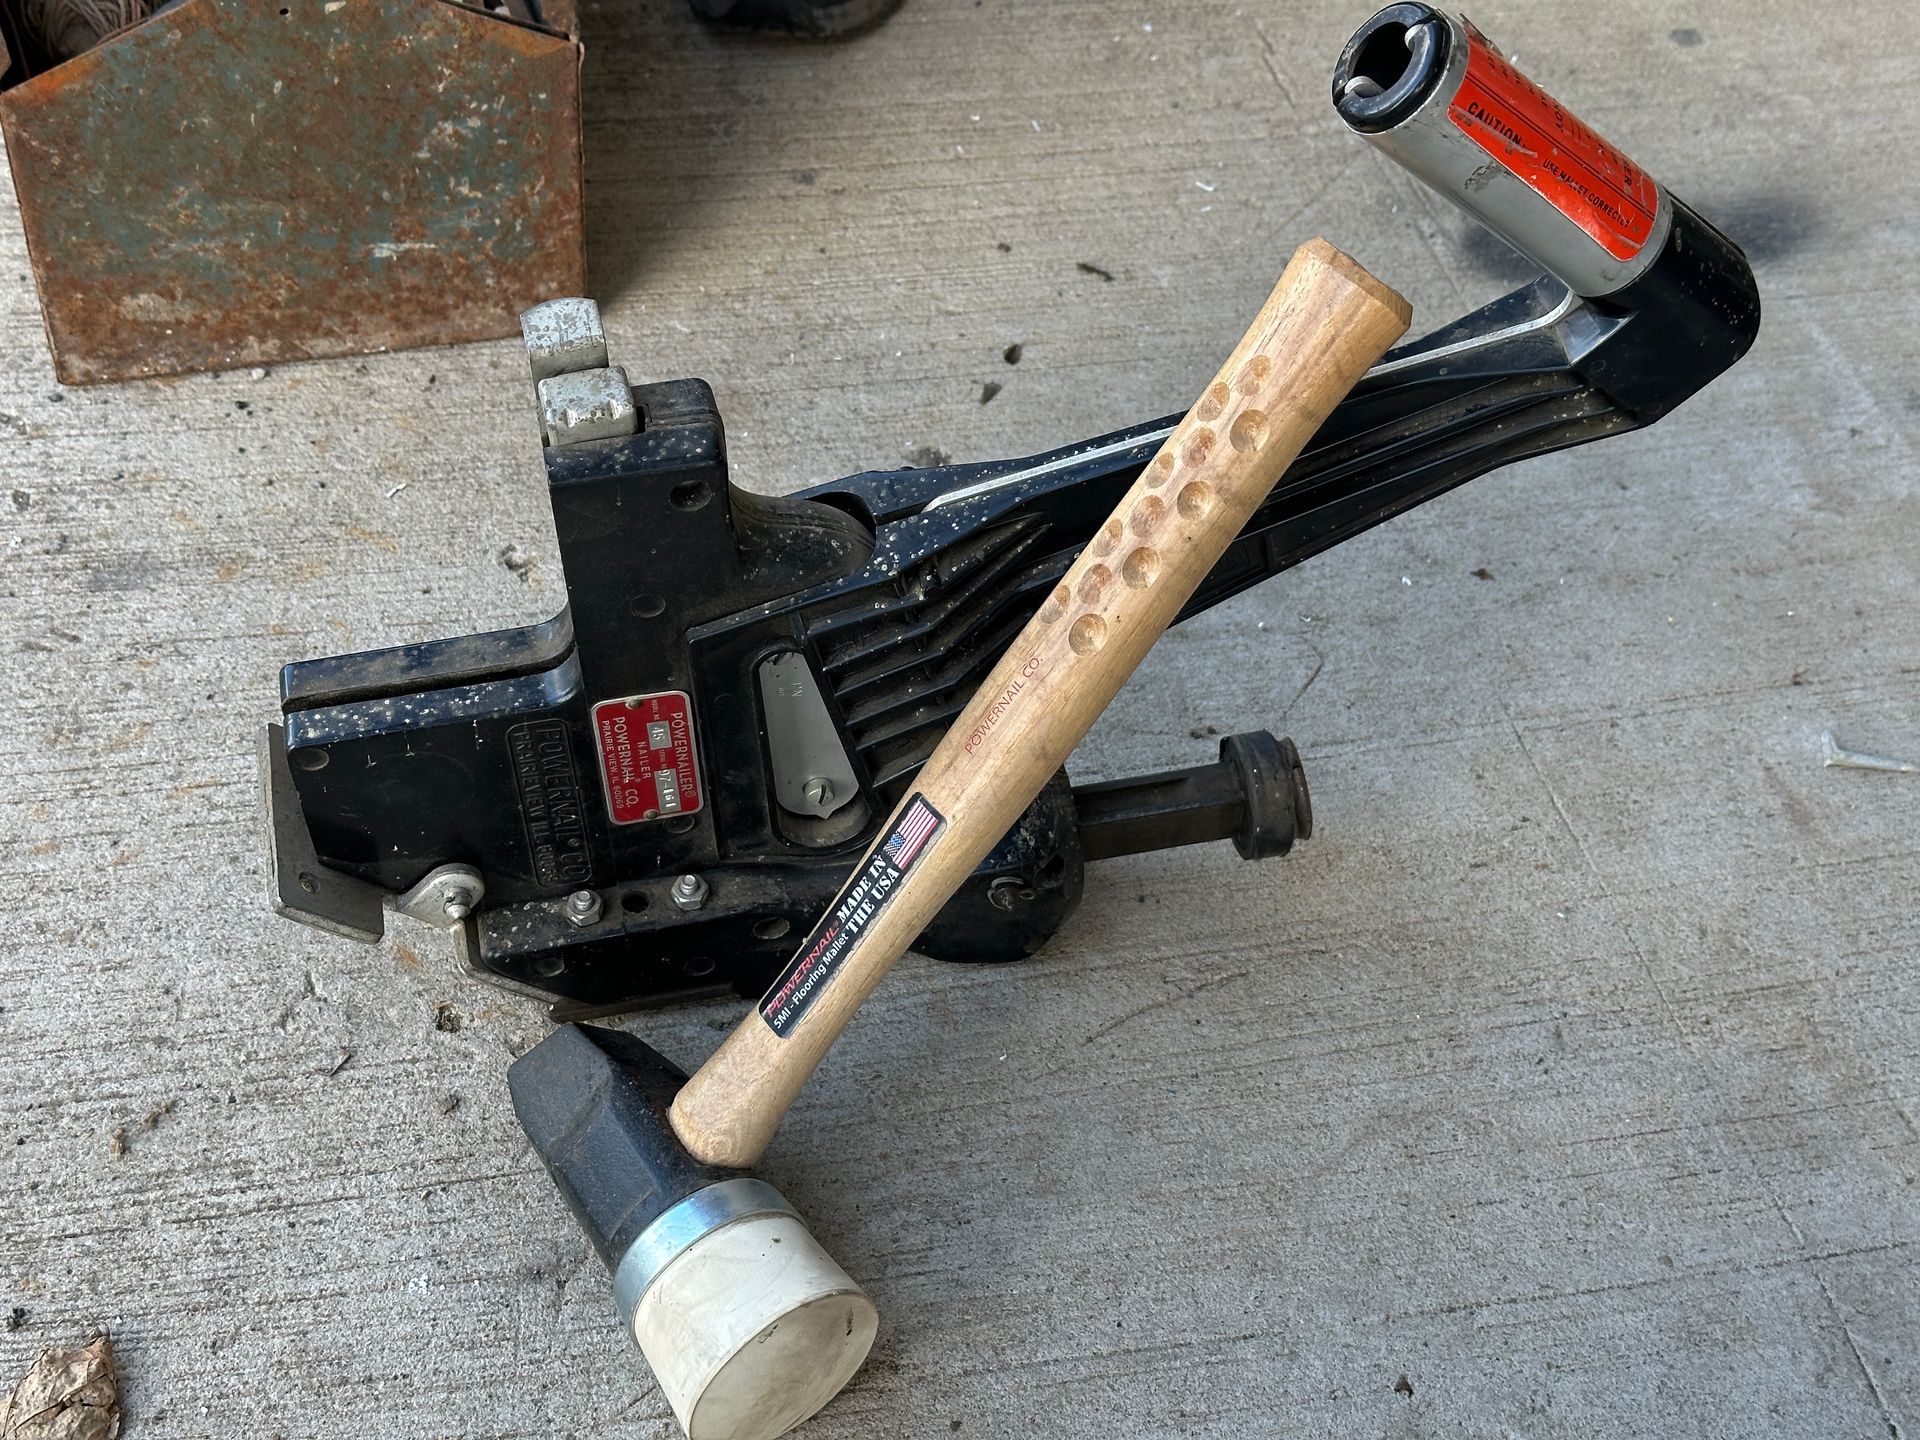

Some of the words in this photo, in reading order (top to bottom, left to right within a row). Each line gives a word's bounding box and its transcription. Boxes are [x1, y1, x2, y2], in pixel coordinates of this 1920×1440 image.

[1543, 159, 1559, 175] USE
[964, 681, 1025, 754] POWERNAIL
[1022, 657, 1043, 677] CO.
[602, 720, 615, 752] PRAIRIE
[612, 716, 635, 784] POWERNAIL
[637, 740, 652, 779] NAILER
[611, 775, 620, 784] IL
[613, 785, 625, 809] 60069
[837, 876, 872, 923] MADE
[868, 854, 887, 879] IN
[792, 962, 827, 1007] Flooring
[824, 932, 849, 966] Mallet
[845, 902, 875, 934] THE
[872, 867, 900, 900] USA
